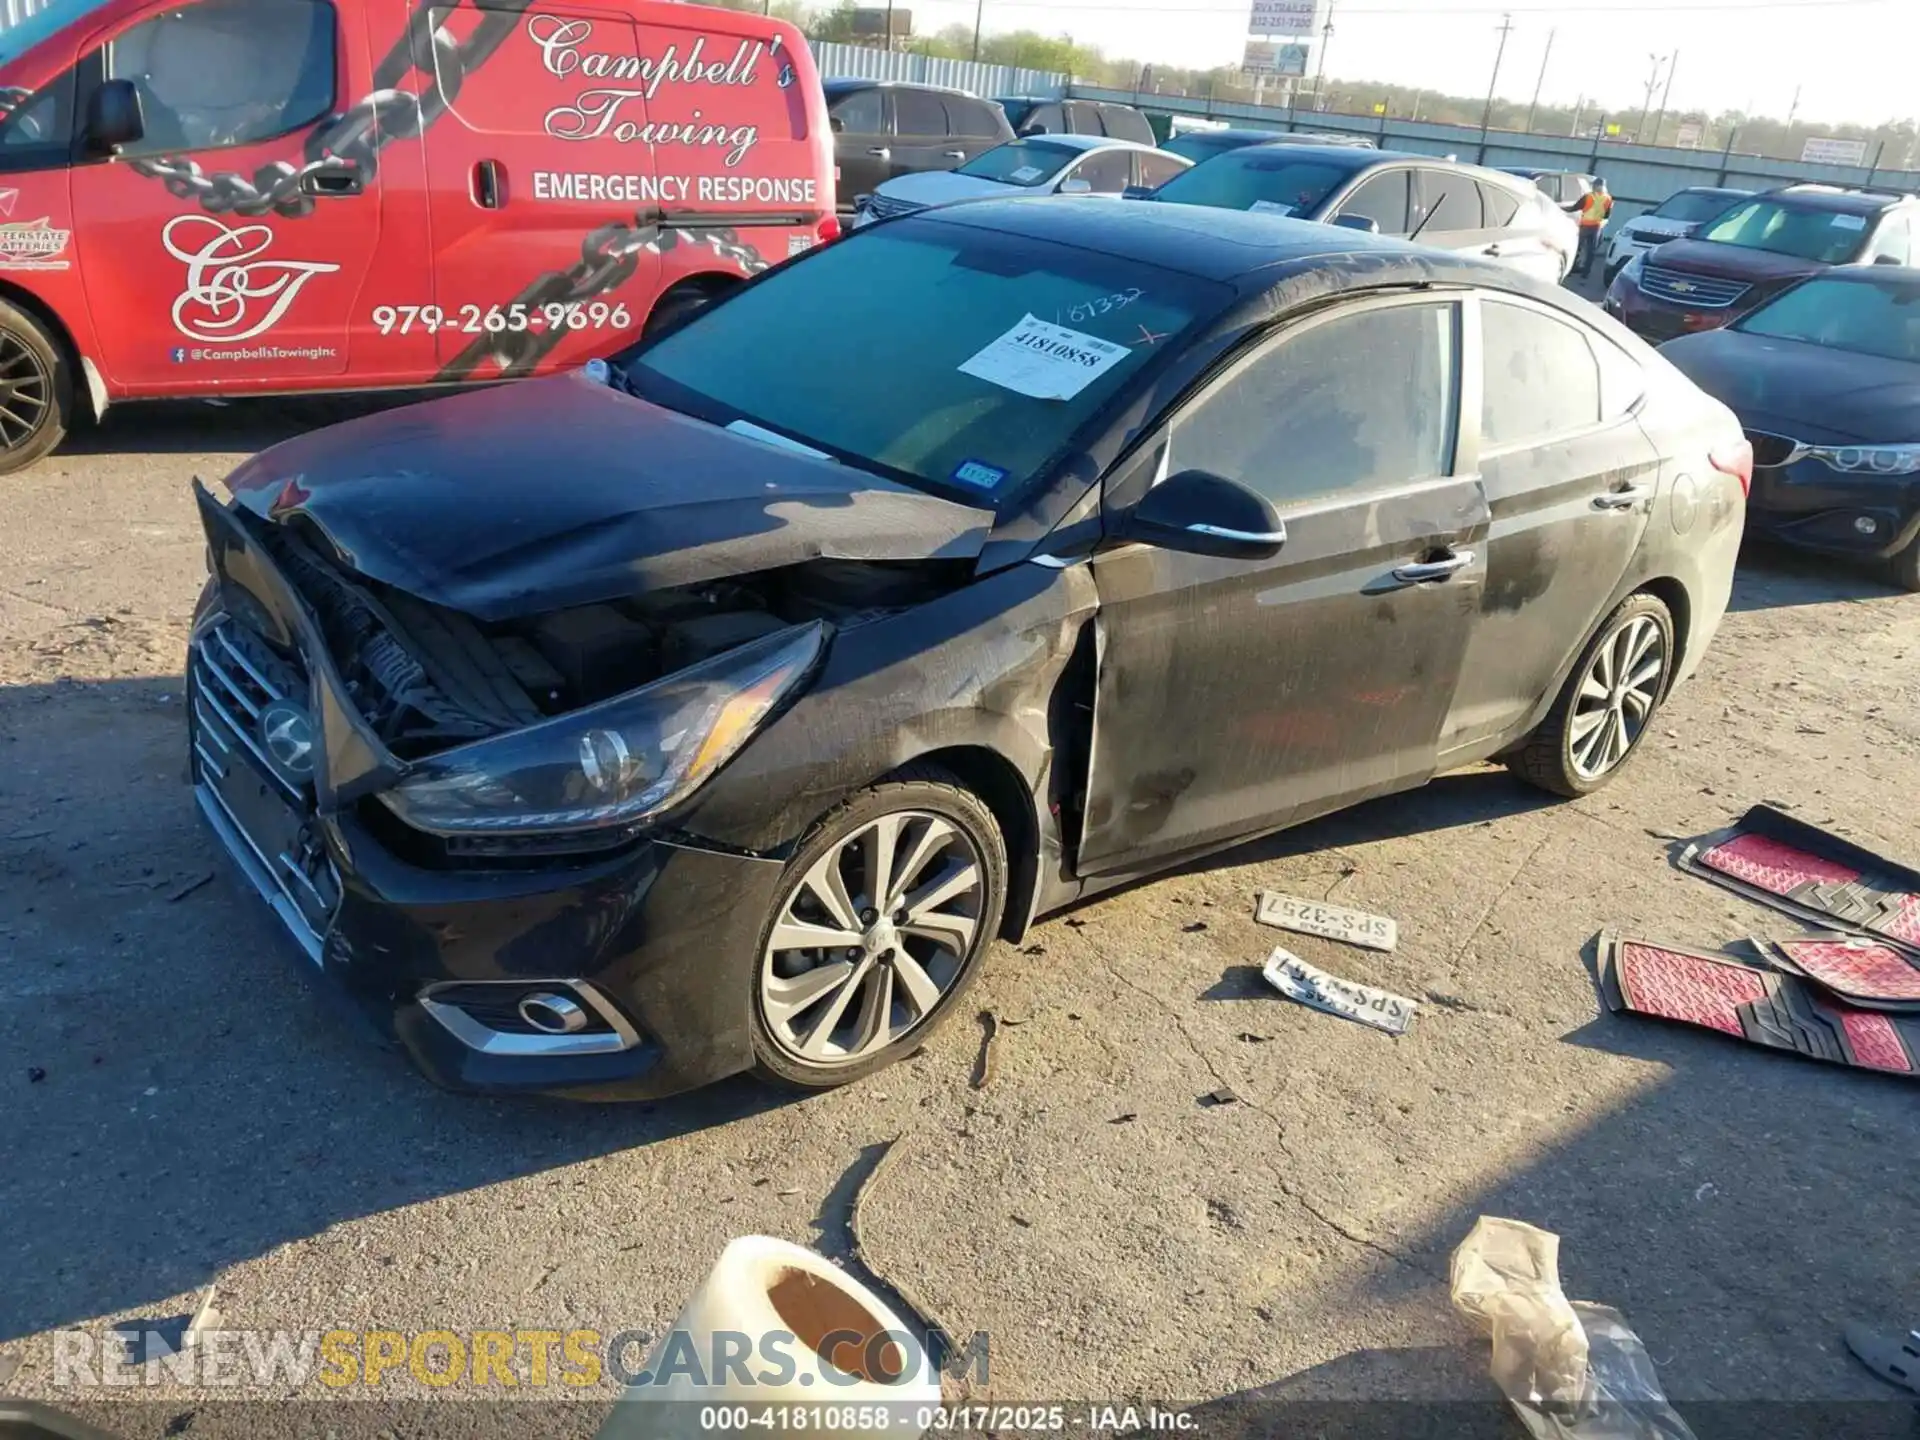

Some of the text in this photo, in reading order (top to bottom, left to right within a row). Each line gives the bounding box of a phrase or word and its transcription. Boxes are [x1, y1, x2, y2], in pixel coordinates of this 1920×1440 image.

[528, 14, 795, 99] Campbell's
[544, 88, 758, 168] Towing
[533, 171, 817, 203] EMERGENCY RESPONSE
[371, 301, 632, 335] 979-265-9696
[190, 346, 337, 362] @CampbellsTowingInc
[1014, 331, 1102, 368] 41810858
